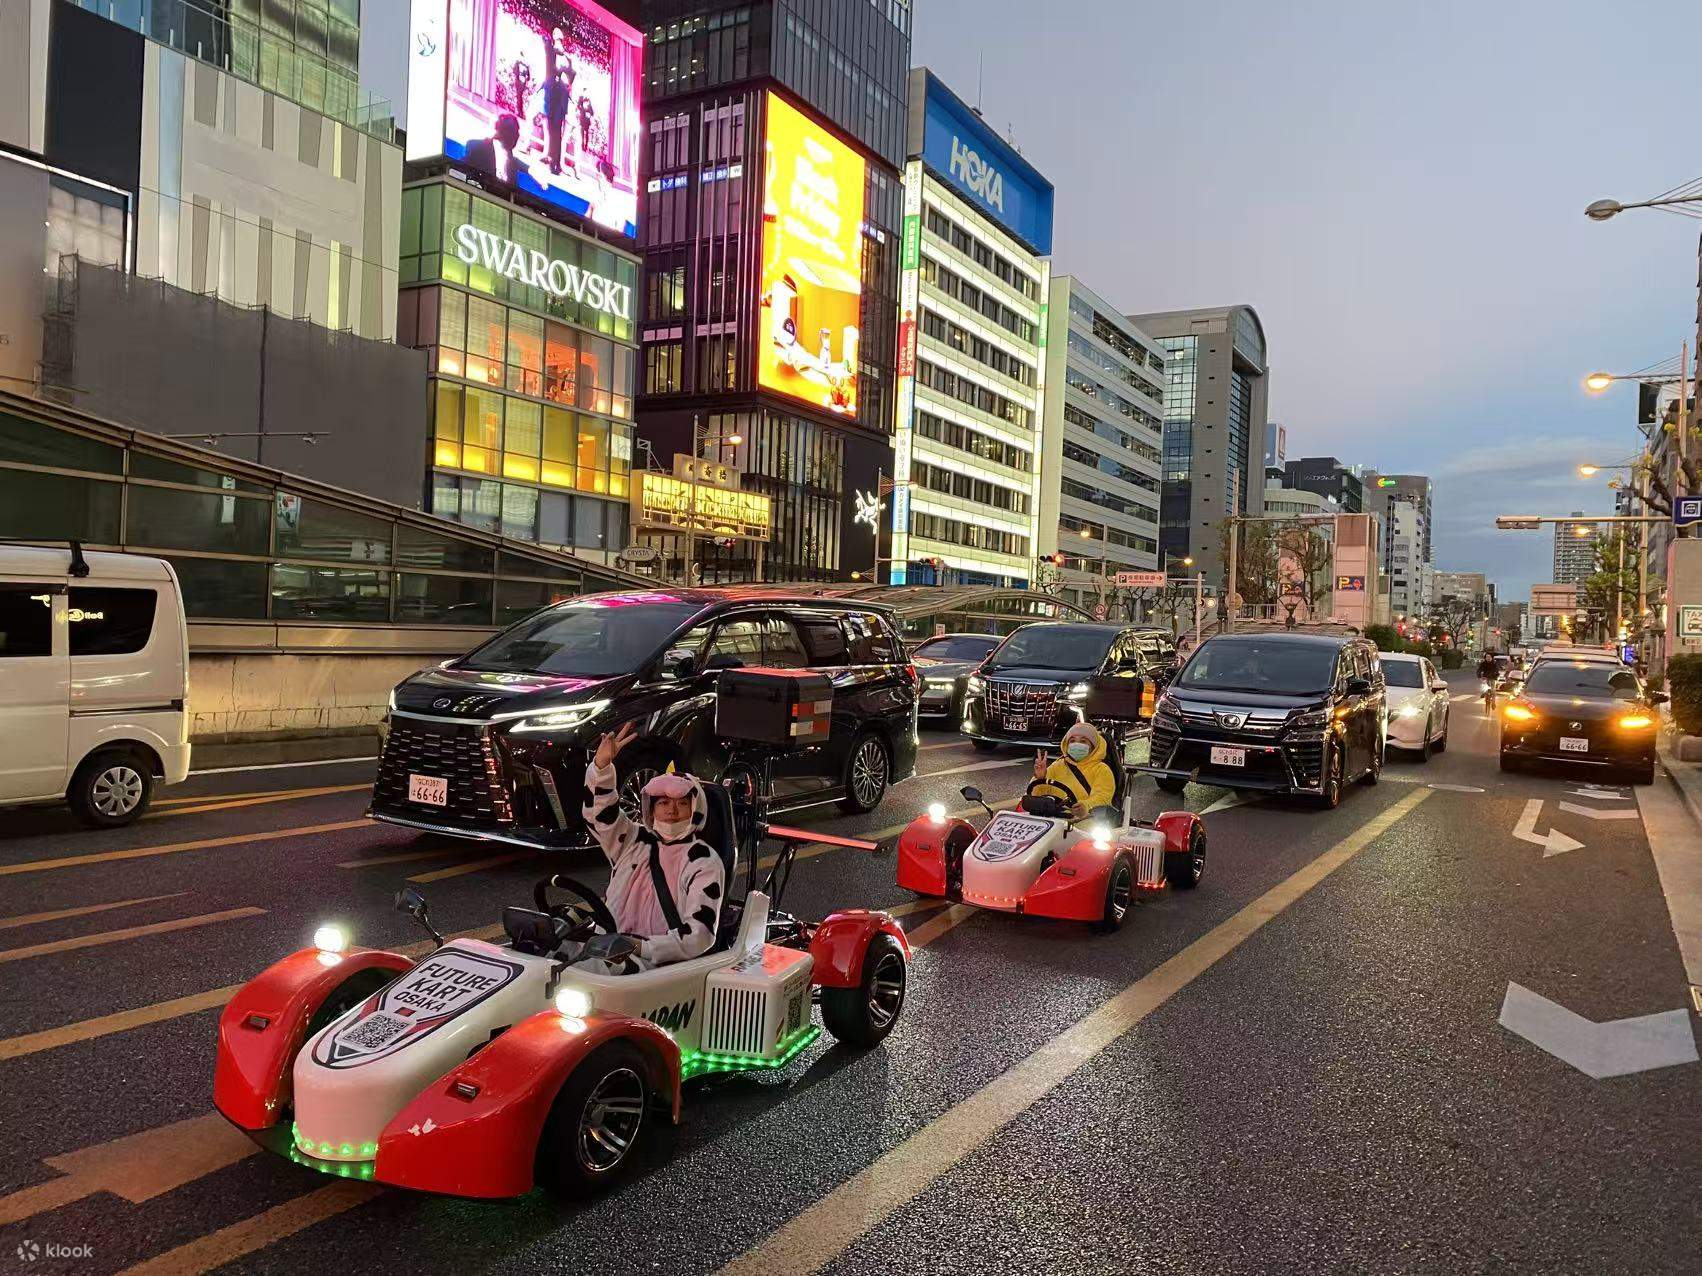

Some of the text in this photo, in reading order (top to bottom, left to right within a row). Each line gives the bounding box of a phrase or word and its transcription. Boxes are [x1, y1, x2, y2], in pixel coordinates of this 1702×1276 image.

[950, 136, 1003, 213] HOKA
[457, 223, 632, 320] SWAROVSKI
[1338, 577, 1350, 590] P
[416, 787, 444, 803] 66-66
[997, 820, 1044, 831] FUTURE
[997, 826, 1034, 836] KART
[994, 832, 1026, 840] OSAKA
[418, 962, 498, 991] FUTURE
[407, 977, 471, 1001] KART
[393, 991, 446, 1012] OSAKA
